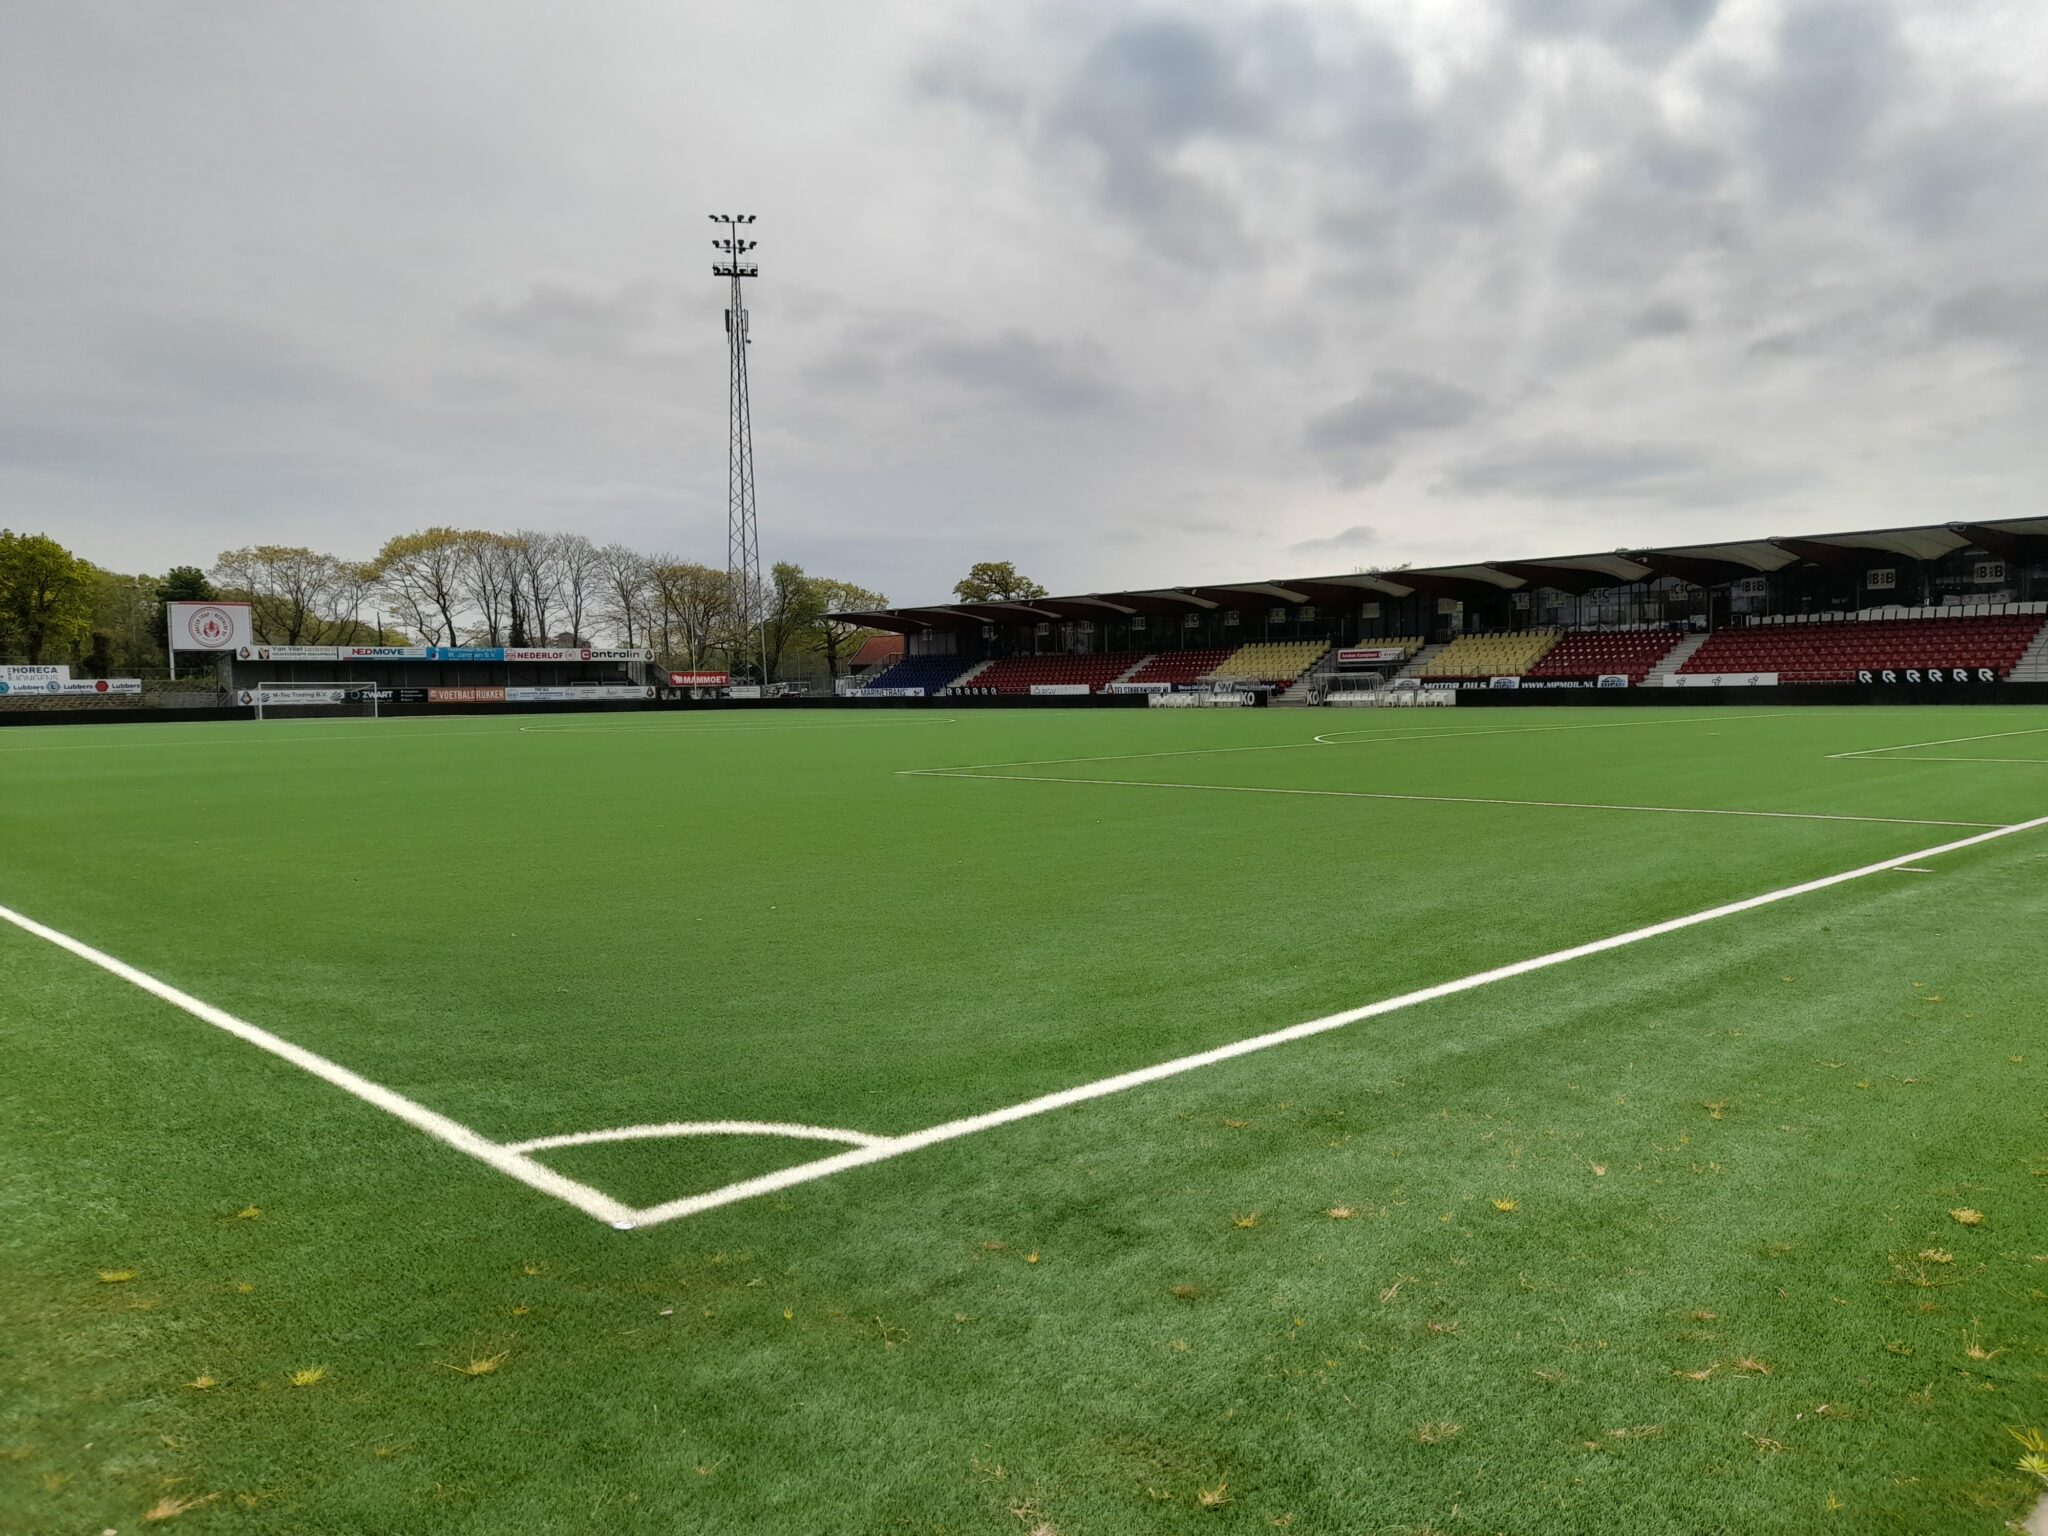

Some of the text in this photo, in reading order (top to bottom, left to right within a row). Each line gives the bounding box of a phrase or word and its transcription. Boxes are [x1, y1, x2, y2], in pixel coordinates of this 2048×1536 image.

[12, 666, 57, 674] HORECA
[683, 675, 727, 684] MAMMOET
[1521, 681, 1596, 689] WWW.MPMOIL.NL
[362, 690, 393, 699] ZWART
